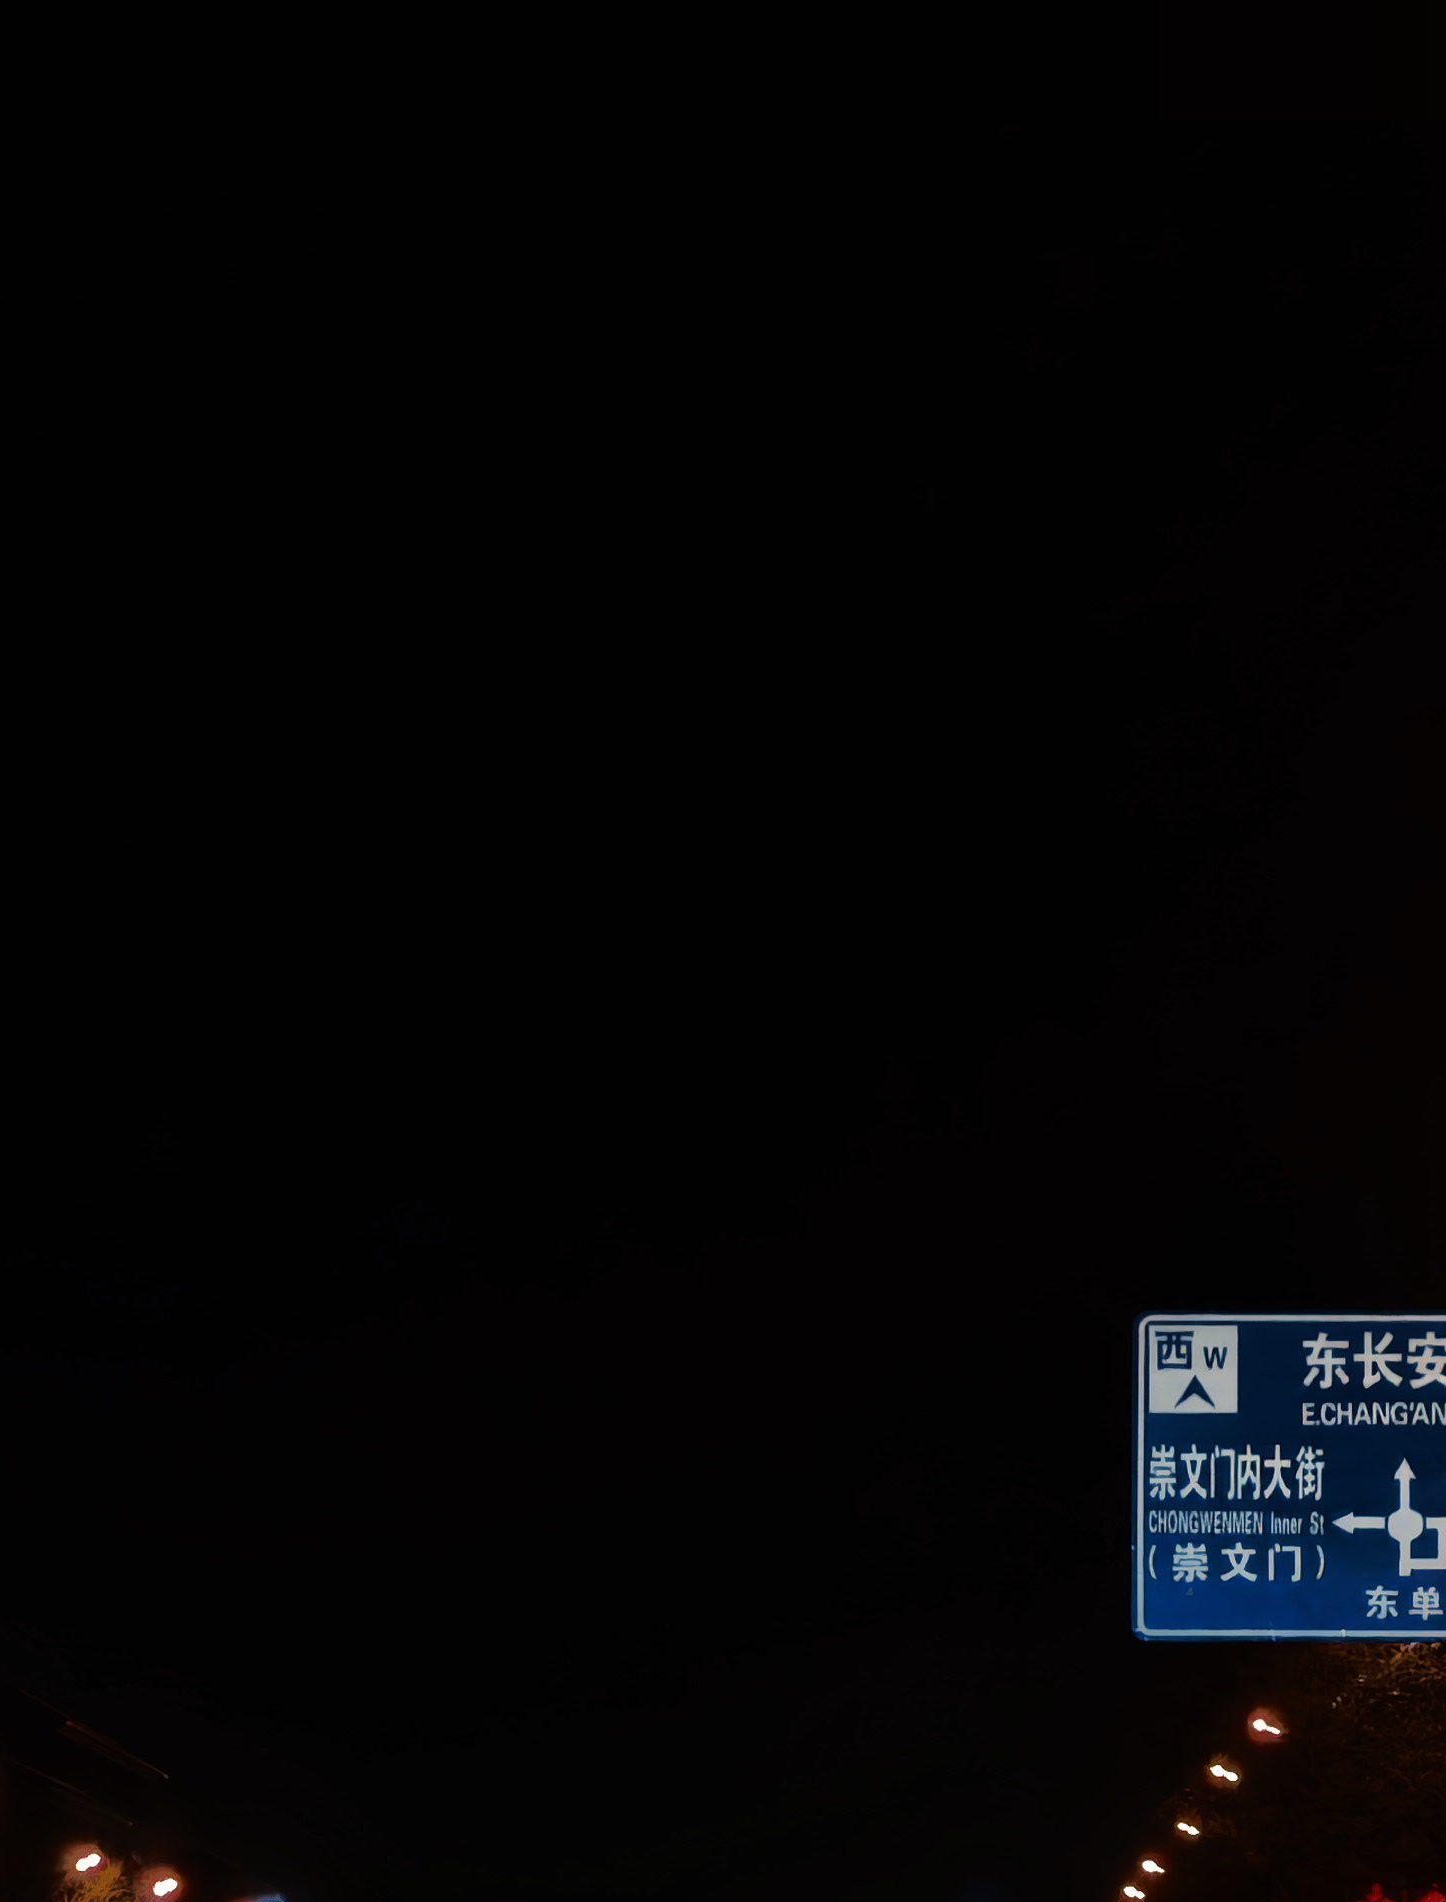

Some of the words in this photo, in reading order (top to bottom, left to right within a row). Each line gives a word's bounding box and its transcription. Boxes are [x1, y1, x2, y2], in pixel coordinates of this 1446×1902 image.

[1155, 1331, 1194, 1370] 西
[1203, 1346, 1228, 1370] W
[1149, 1443, 1325, 1501] 崇文门内大街
[1148, 1510, 1263, 1535] CHONGWENMEN
[1270, 1511, 1303, 1535] Inner
[1310, 1511, 1325, 1535] St
[1365, 1585, 1444, 1621] 东单
